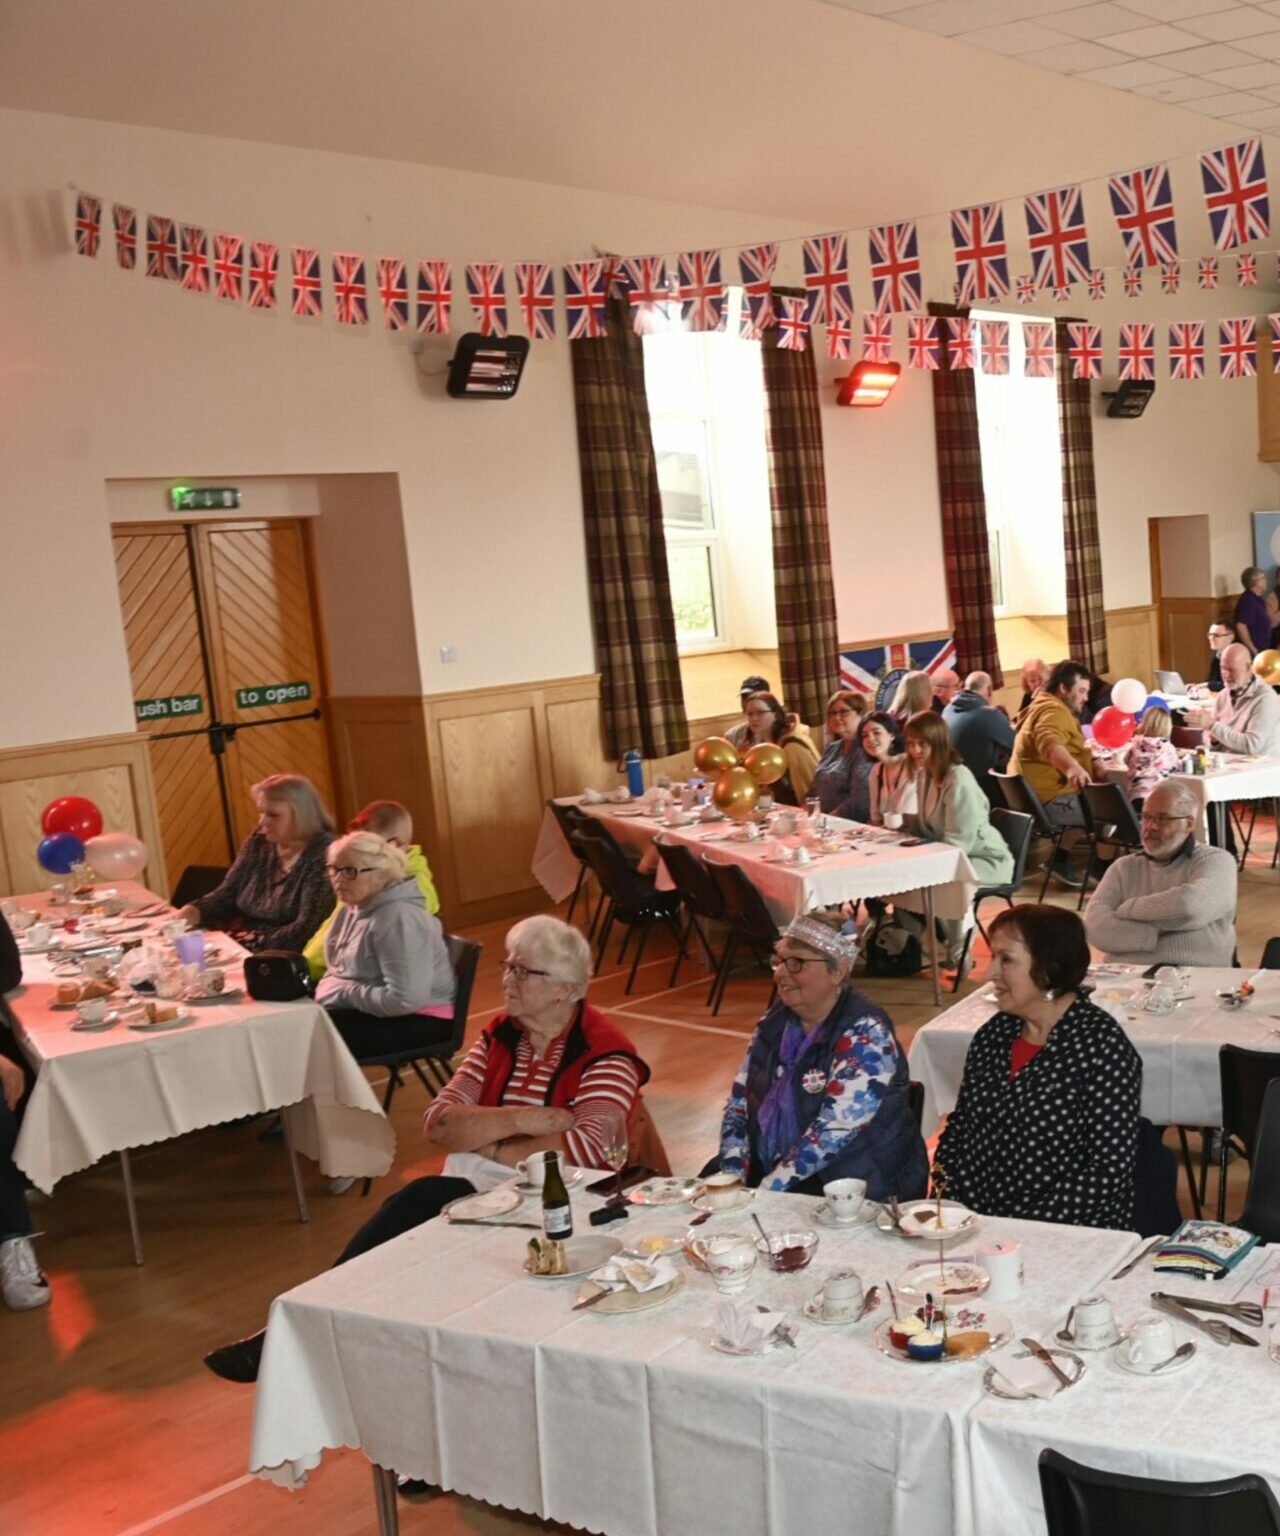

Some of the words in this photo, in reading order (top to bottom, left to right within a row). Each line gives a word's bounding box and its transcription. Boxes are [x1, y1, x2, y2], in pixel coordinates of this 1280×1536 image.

[240, 690, 259, 705] to
[265, 684, 309, 704] open
[136, 700, 168, 718] ush
[171, 697, 200, 714] bar
